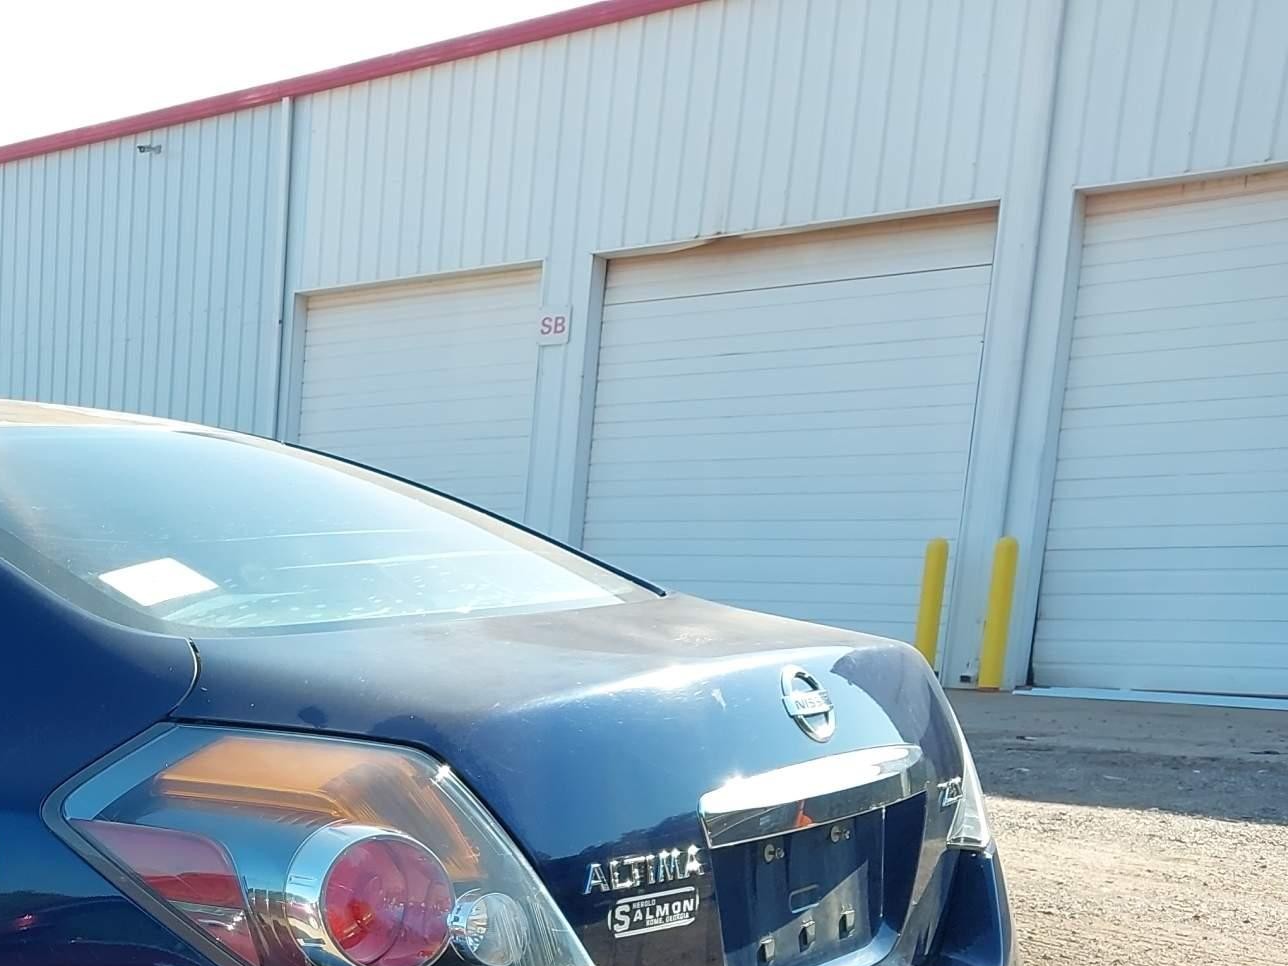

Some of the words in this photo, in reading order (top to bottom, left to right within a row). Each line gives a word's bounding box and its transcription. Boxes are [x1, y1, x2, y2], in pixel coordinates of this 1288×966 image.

[540, 316, 566, 335] SB
[583, 845, 705, 895] ALTIMA
[613, 898, 695, 932] SALMON
